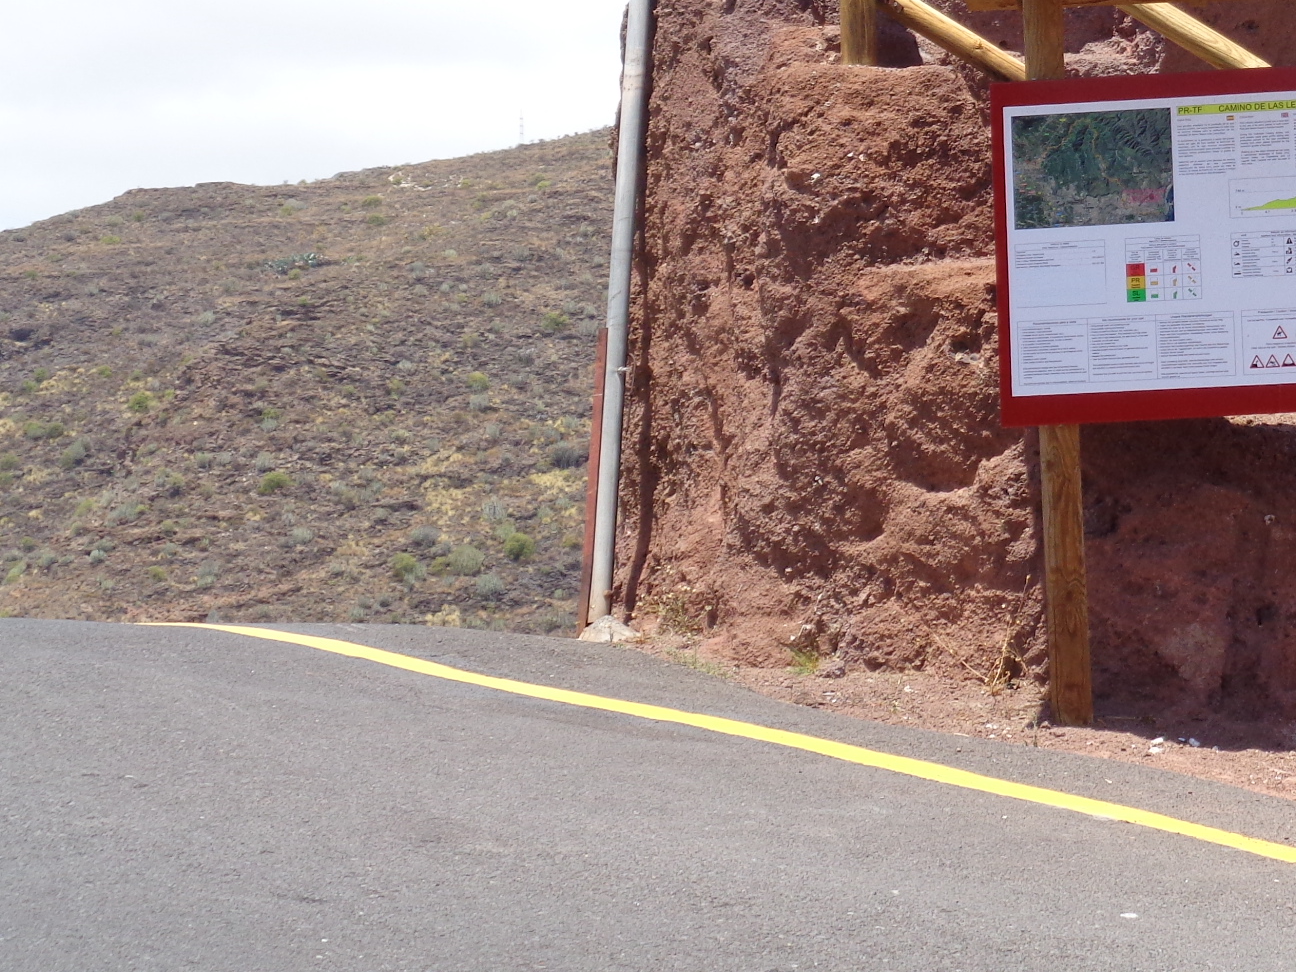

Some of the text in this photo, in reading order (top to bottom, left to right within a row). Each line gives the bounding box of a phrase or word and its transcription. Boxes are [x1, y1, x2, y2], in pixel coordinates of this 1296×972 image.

[1178, 106, 1203, 115] PR-TF
[1218, 103, 1252, 113] CAMINO
[1254, 102, 1266, 111] DE
[1268, 101, 1284, 110] LAS
